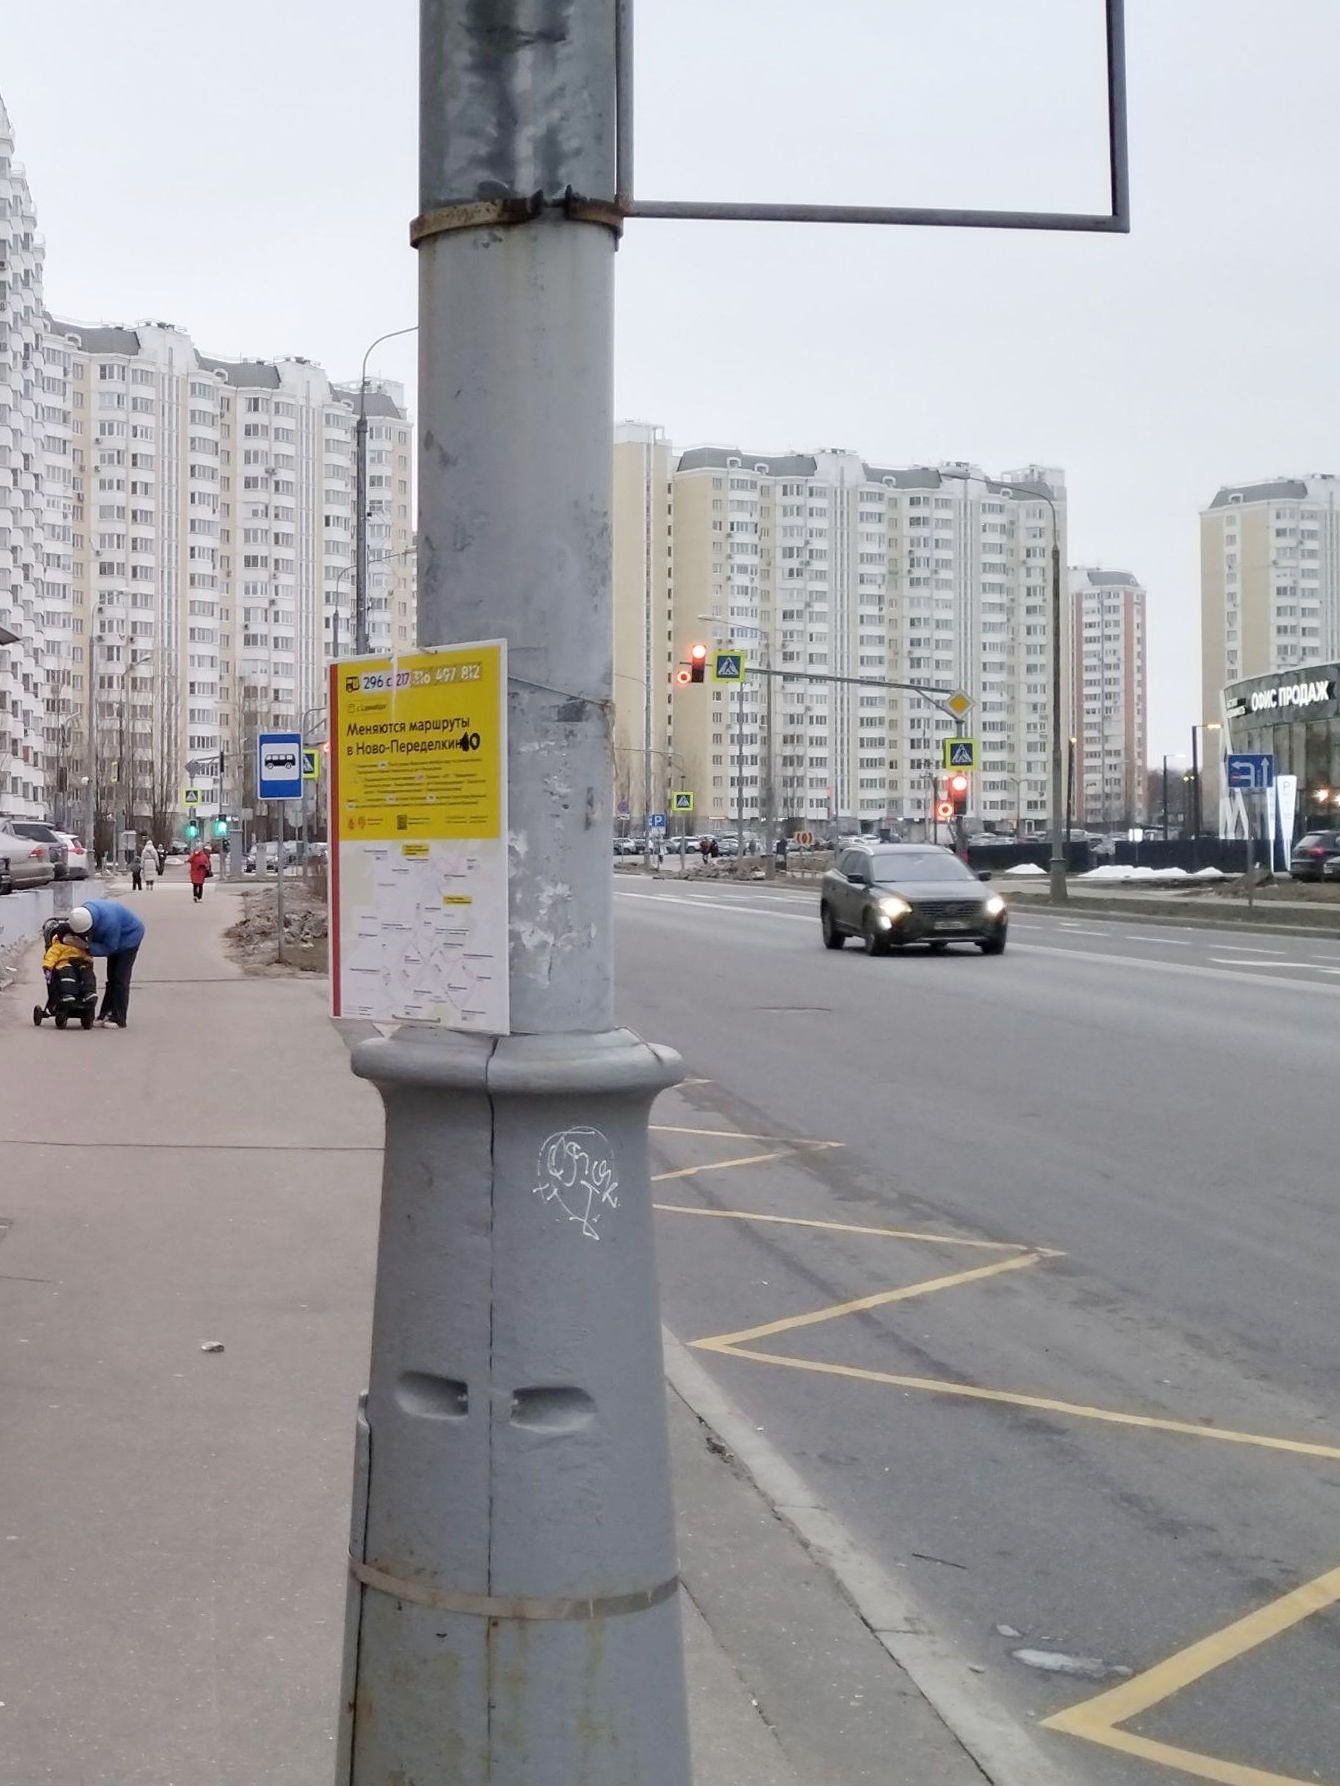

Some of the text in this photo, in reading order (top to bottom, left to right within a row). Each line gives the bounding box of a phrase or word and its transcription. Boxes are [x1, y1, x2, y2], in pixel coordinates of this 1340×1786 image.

[363, 675, 383, 690] 296
[1251, 688, 1277, 711] ОФИС
[1278, 681, 1329, 707] ПРОДАЖ
[347, 717, 470, 736] Меняются маршруты
[347, 746, 353, 756] в
